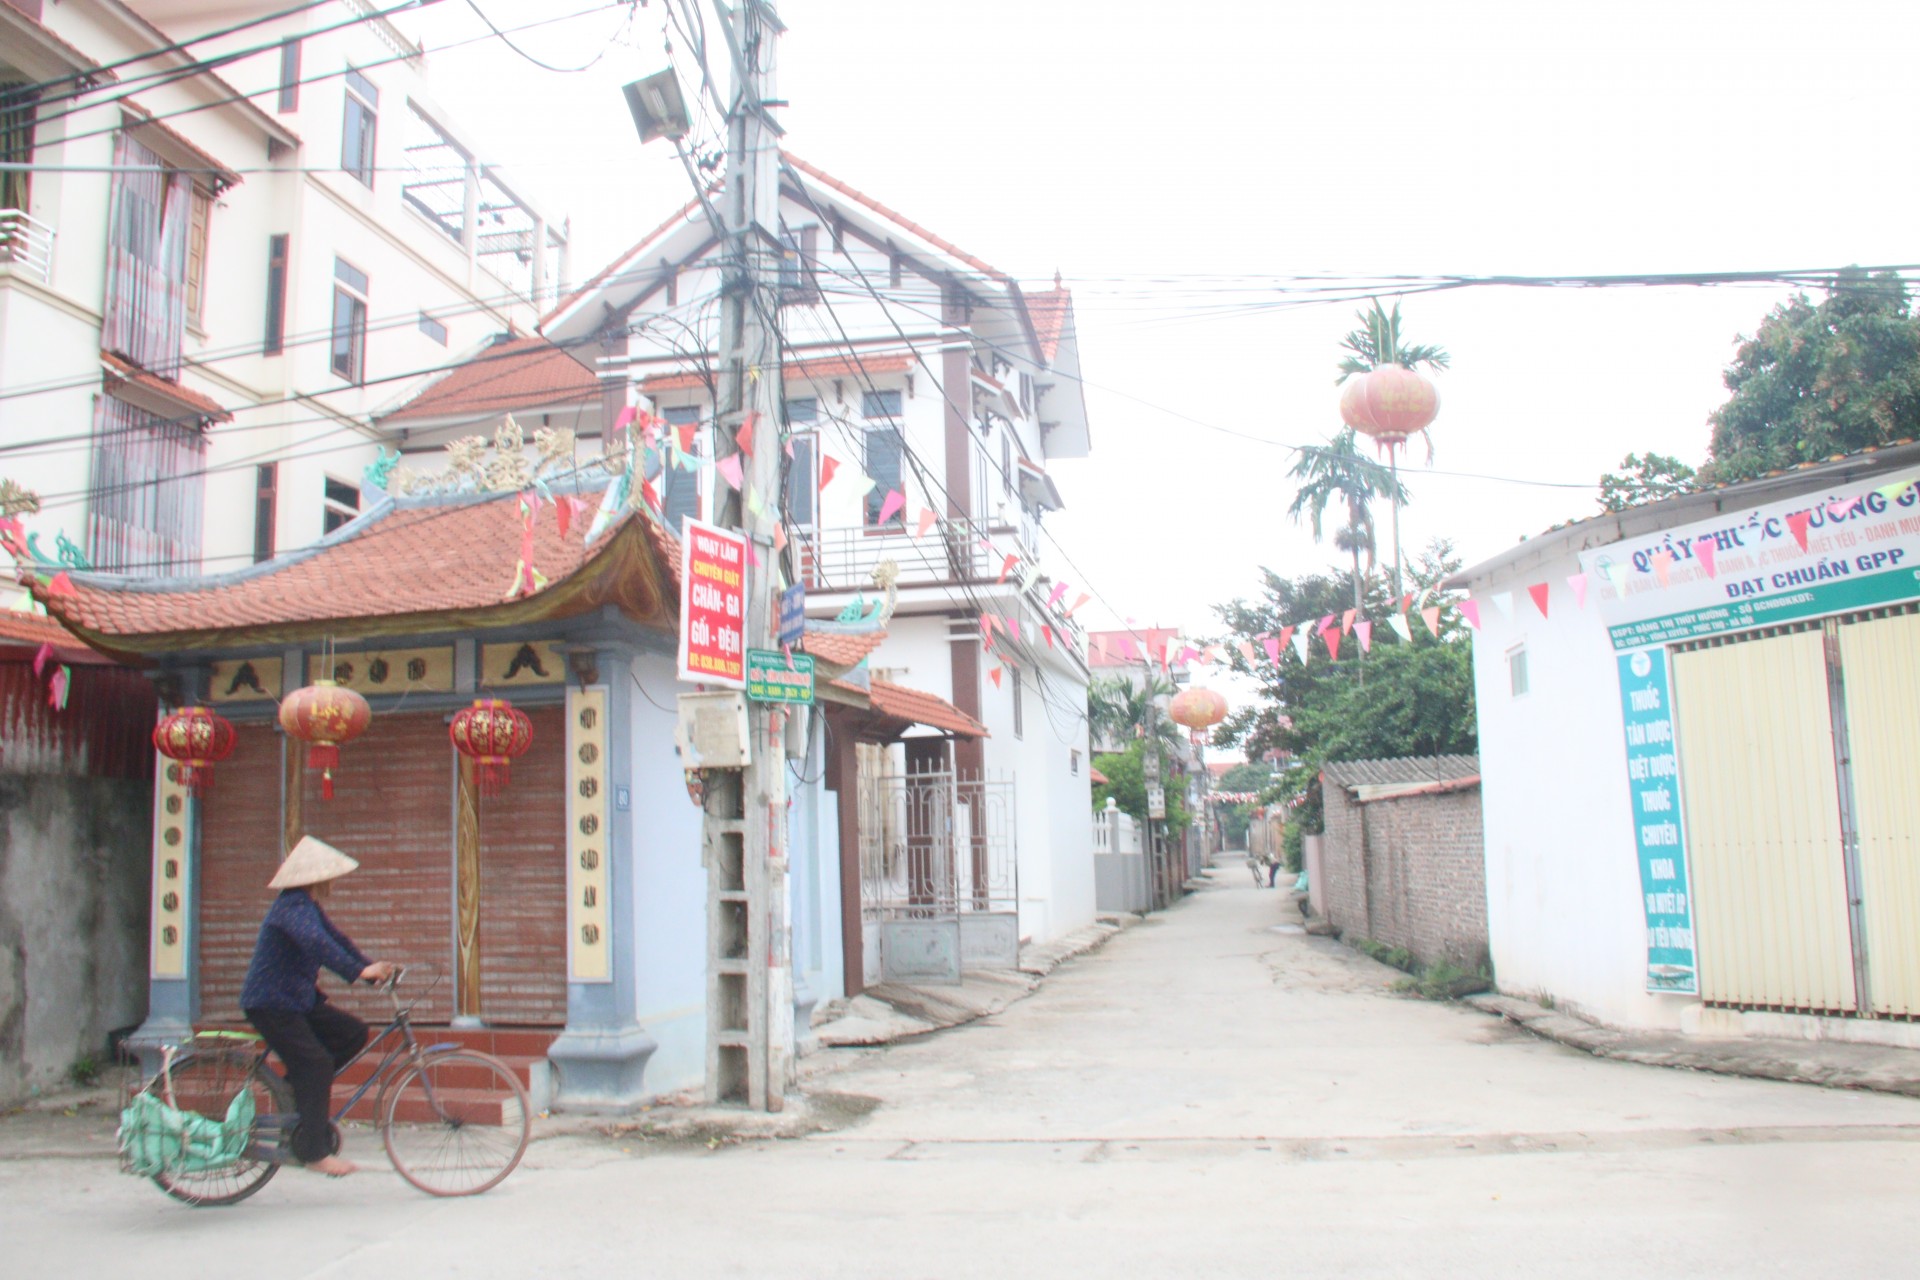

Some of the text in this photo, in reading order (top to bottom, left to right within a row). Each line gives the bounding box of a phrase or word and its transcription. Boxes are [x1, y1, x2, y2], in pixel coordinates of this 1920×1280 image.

[1864, 521, 1898, 542] DANH
[1726, 548, 1904, 598] ĐẠT CHUẨN GPP
[726, 594, 740, 618] GA
[691, 616, 740, 656] GỐI ĐỆM
[1629, 681, 1661, 712] THUỐC
[1626, 719, 1671, 748] TÂN DƯỢC
[1629, 753, 1677, 784] BIỆT DƯỢC
[1640, 782, 1672, 812] THUỐC
[1641, 819, 1679, 846] CHUYÊN
[1649, 858, 1677, 880] KHOA
